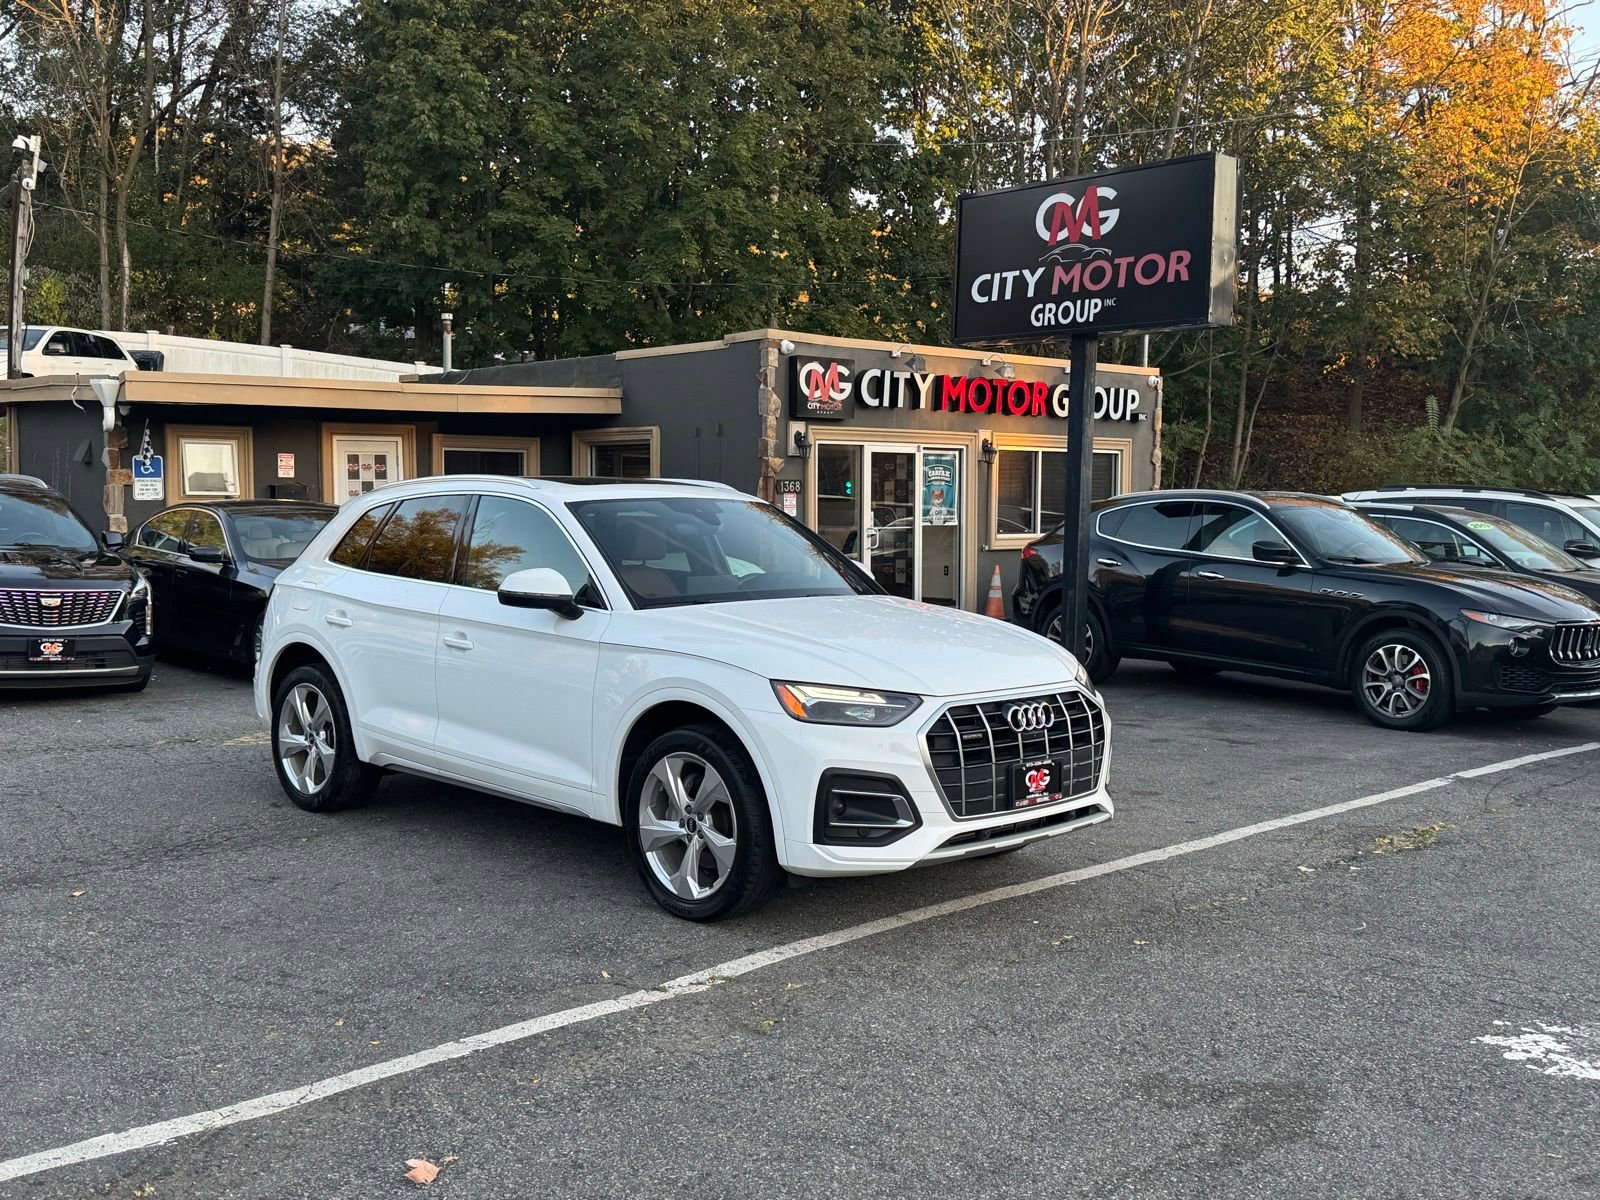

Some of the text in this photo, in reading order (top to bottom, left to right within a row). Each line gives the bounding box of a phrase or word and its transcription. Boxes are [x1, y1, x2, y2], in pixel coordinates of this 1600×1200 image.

[971, 250, 1191, 304] CITY MOTOR
[1030, 297, 1117, 327] GROUP INC
[807, 402, 820, 410] CITY
[860, 368, 1148, 421] CITY MOTOR GOUP INC
[781, 481, 801, 492] 1368
